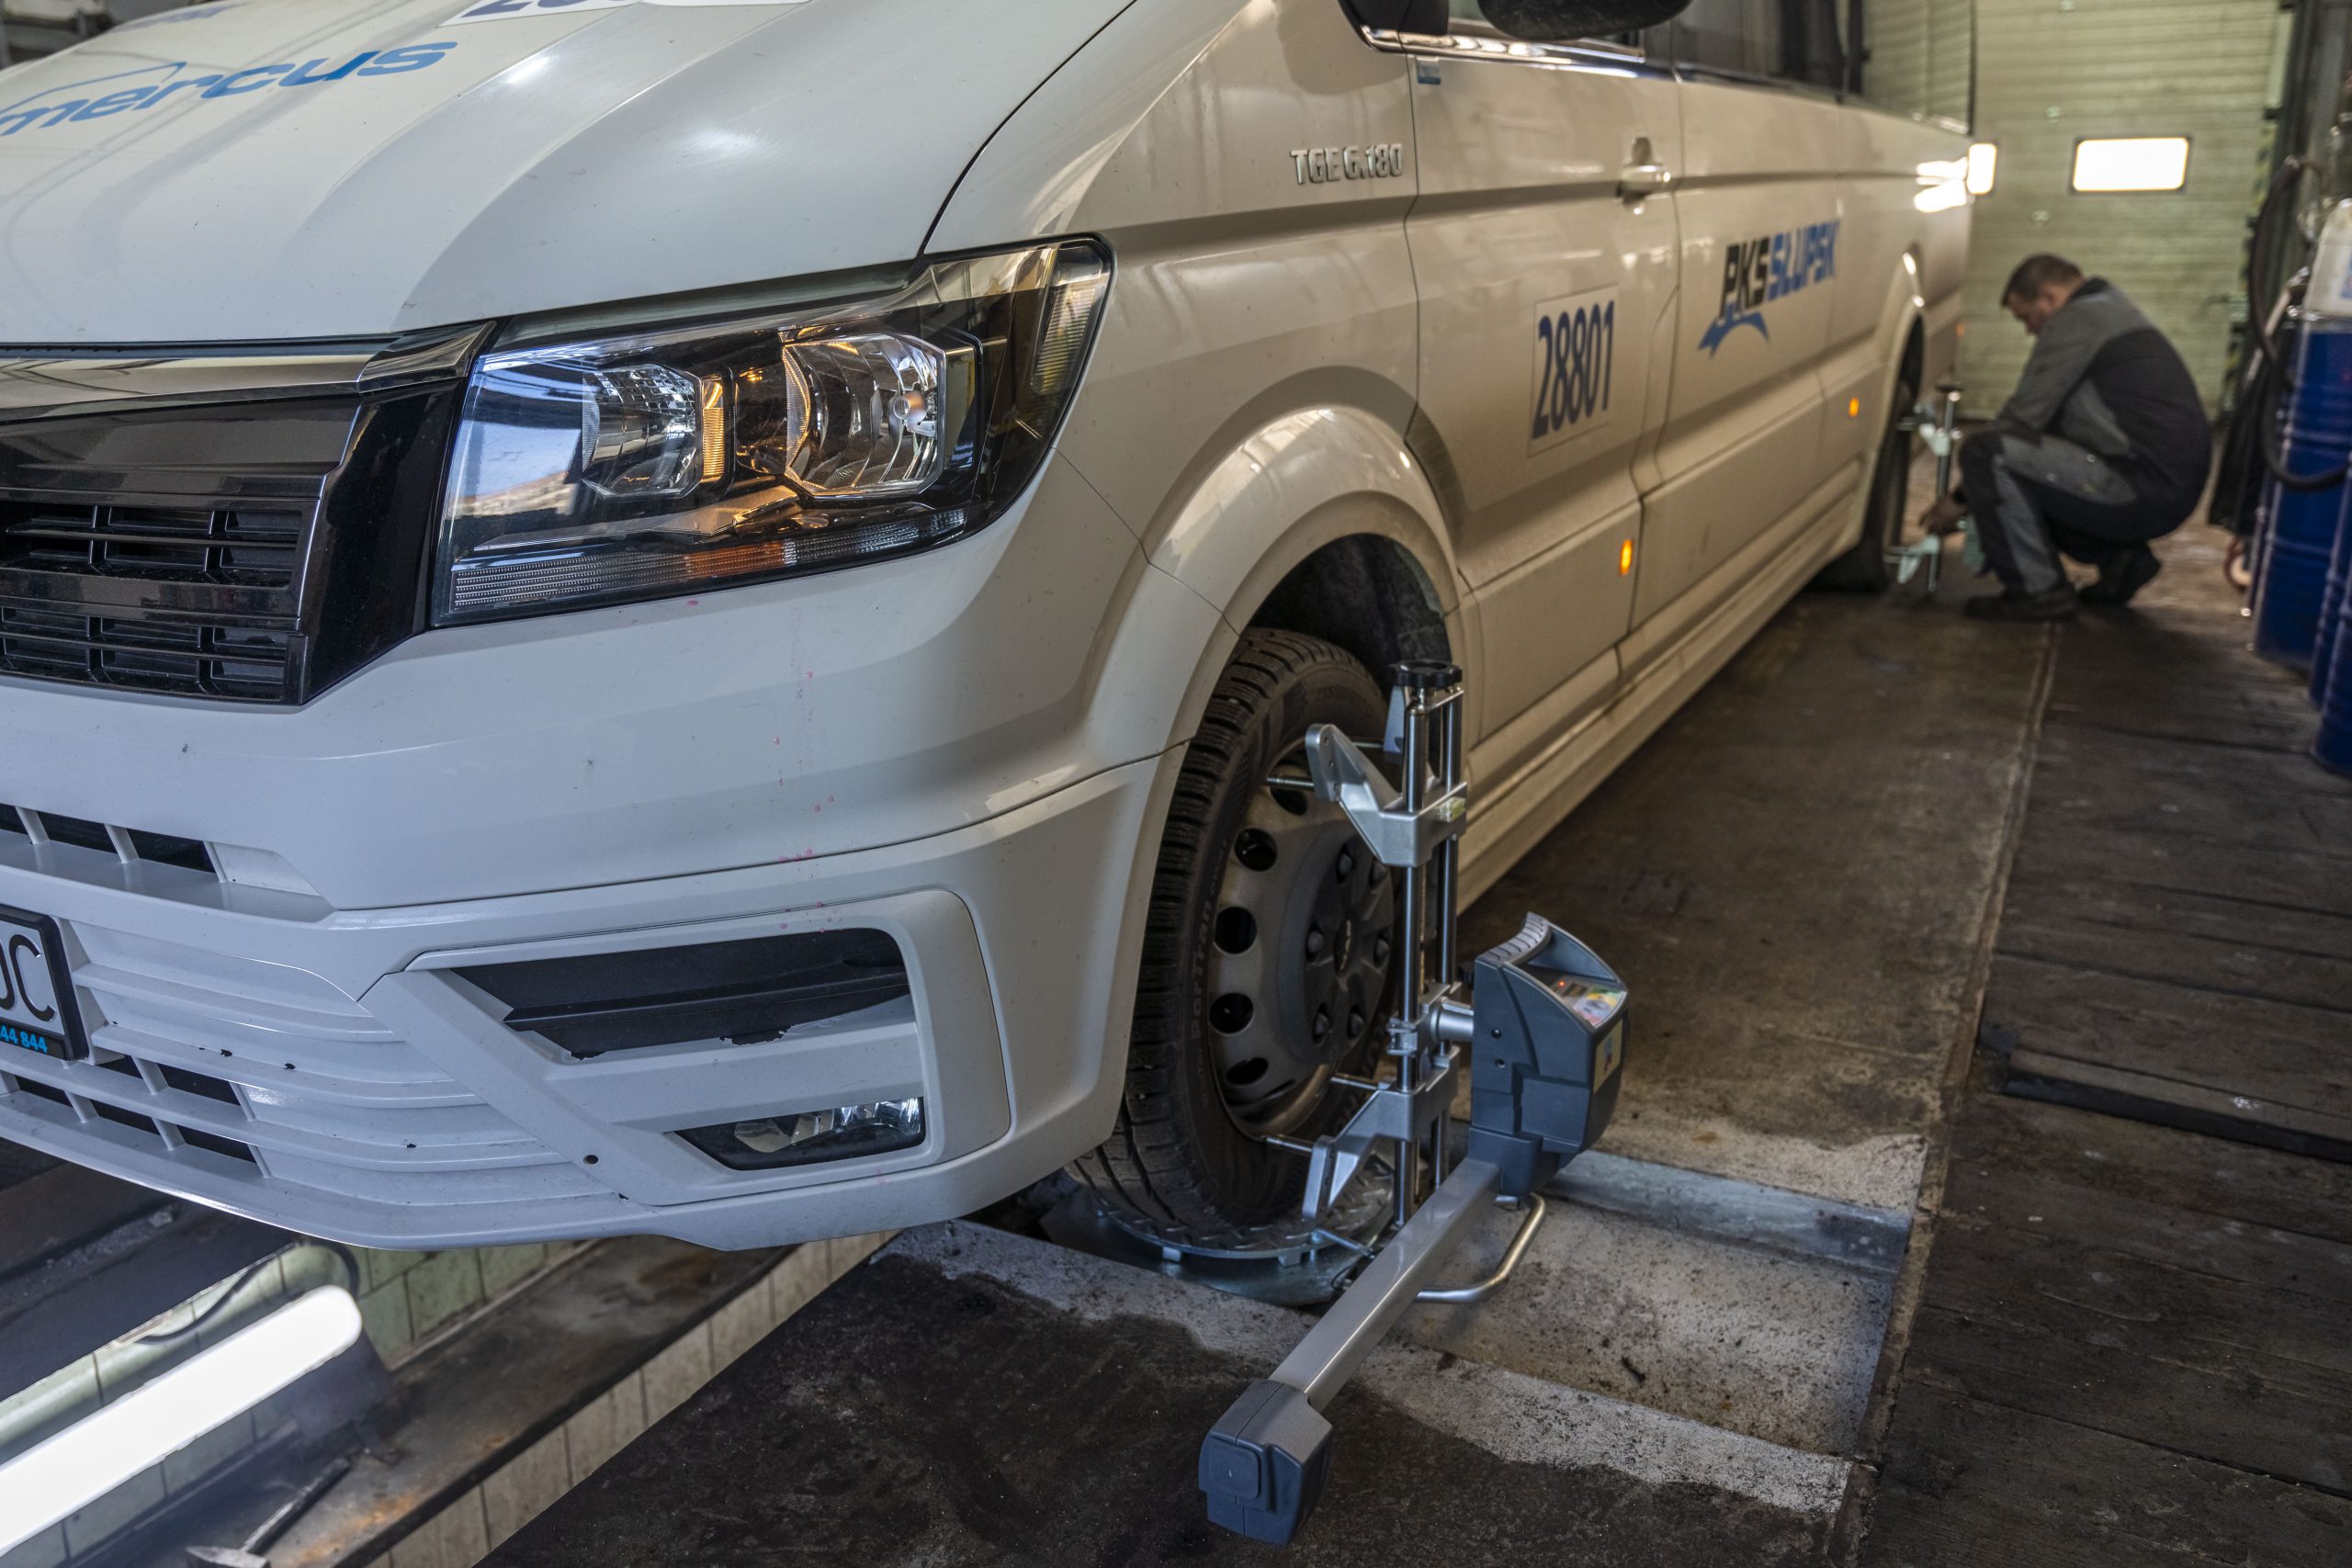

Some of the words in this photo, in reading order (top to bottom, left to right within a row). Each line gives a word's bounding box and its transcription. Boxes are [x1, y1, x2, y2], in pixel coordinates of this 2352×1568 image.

[0, 40, 458, 137] mercus
[1290, 147, 1340, 185] TGE
[1343, 143, 1402, 180] 6.180
[1532, 299, 1615, 441] 28801
[19, 1030, 48, 1054] 844
